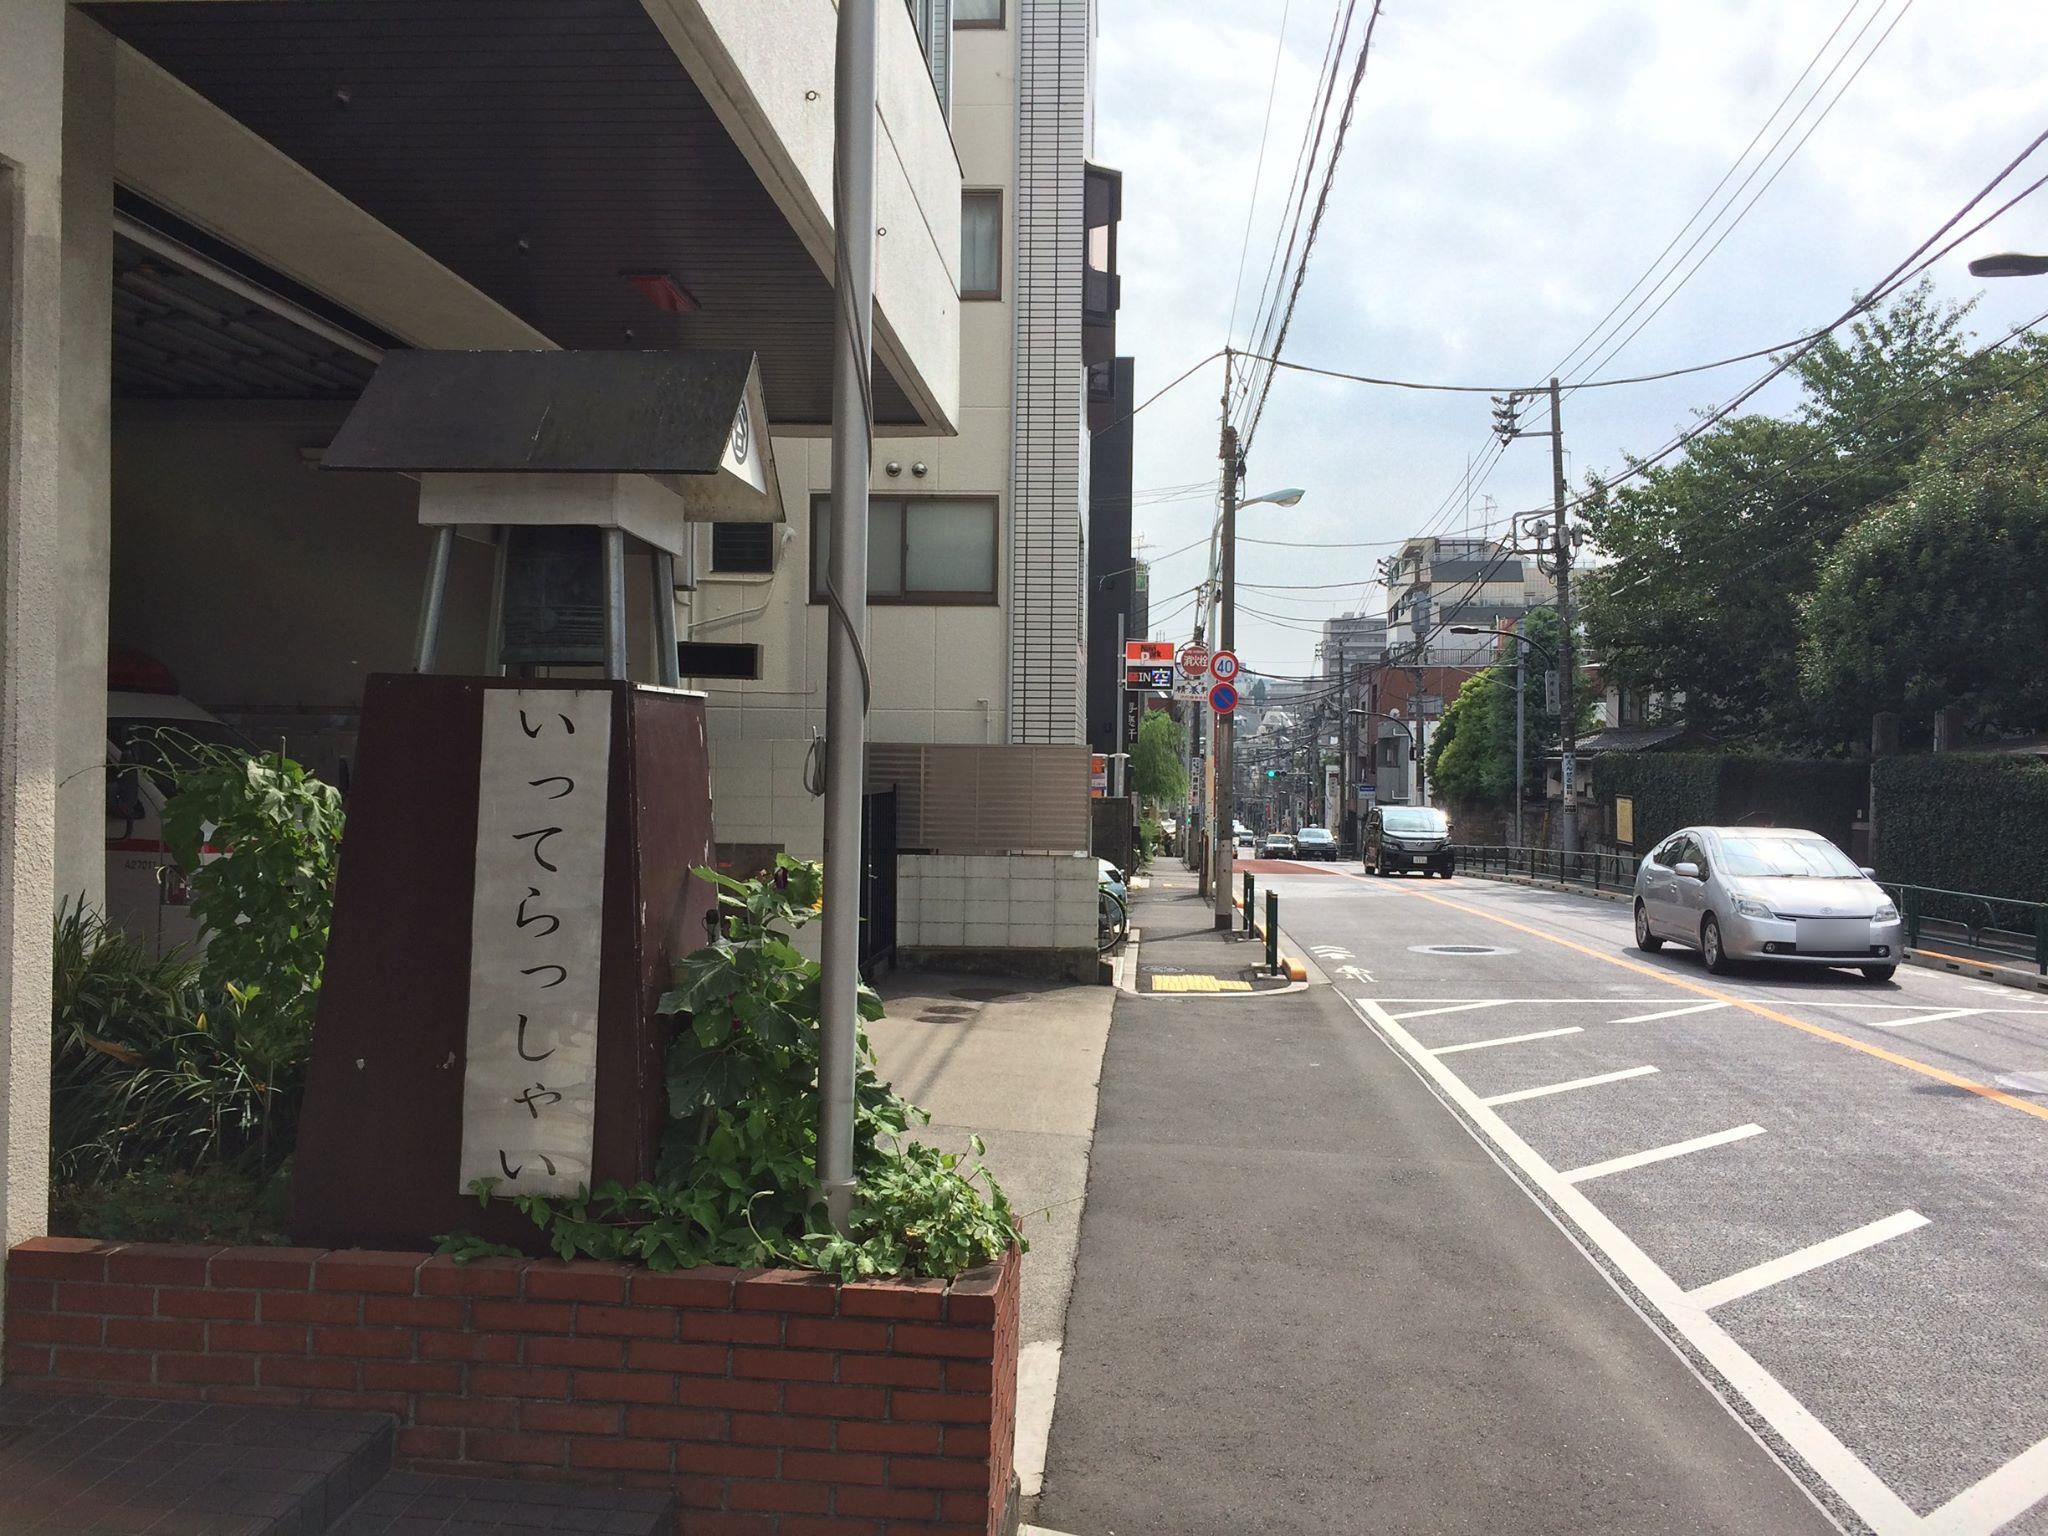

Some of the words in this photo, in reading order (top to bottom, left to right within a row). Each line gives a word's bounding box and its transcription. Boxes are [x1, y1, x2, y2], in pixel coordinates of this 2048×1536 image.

[1184, 655, 1208, 667] 消火栓
[1216, 659, 1233, 673] 40
[1138, 672, 1151, 682] IN
[1151, 668, 1171, 687] 空
[499, 709, 576, 1181] いってらっしゃい
